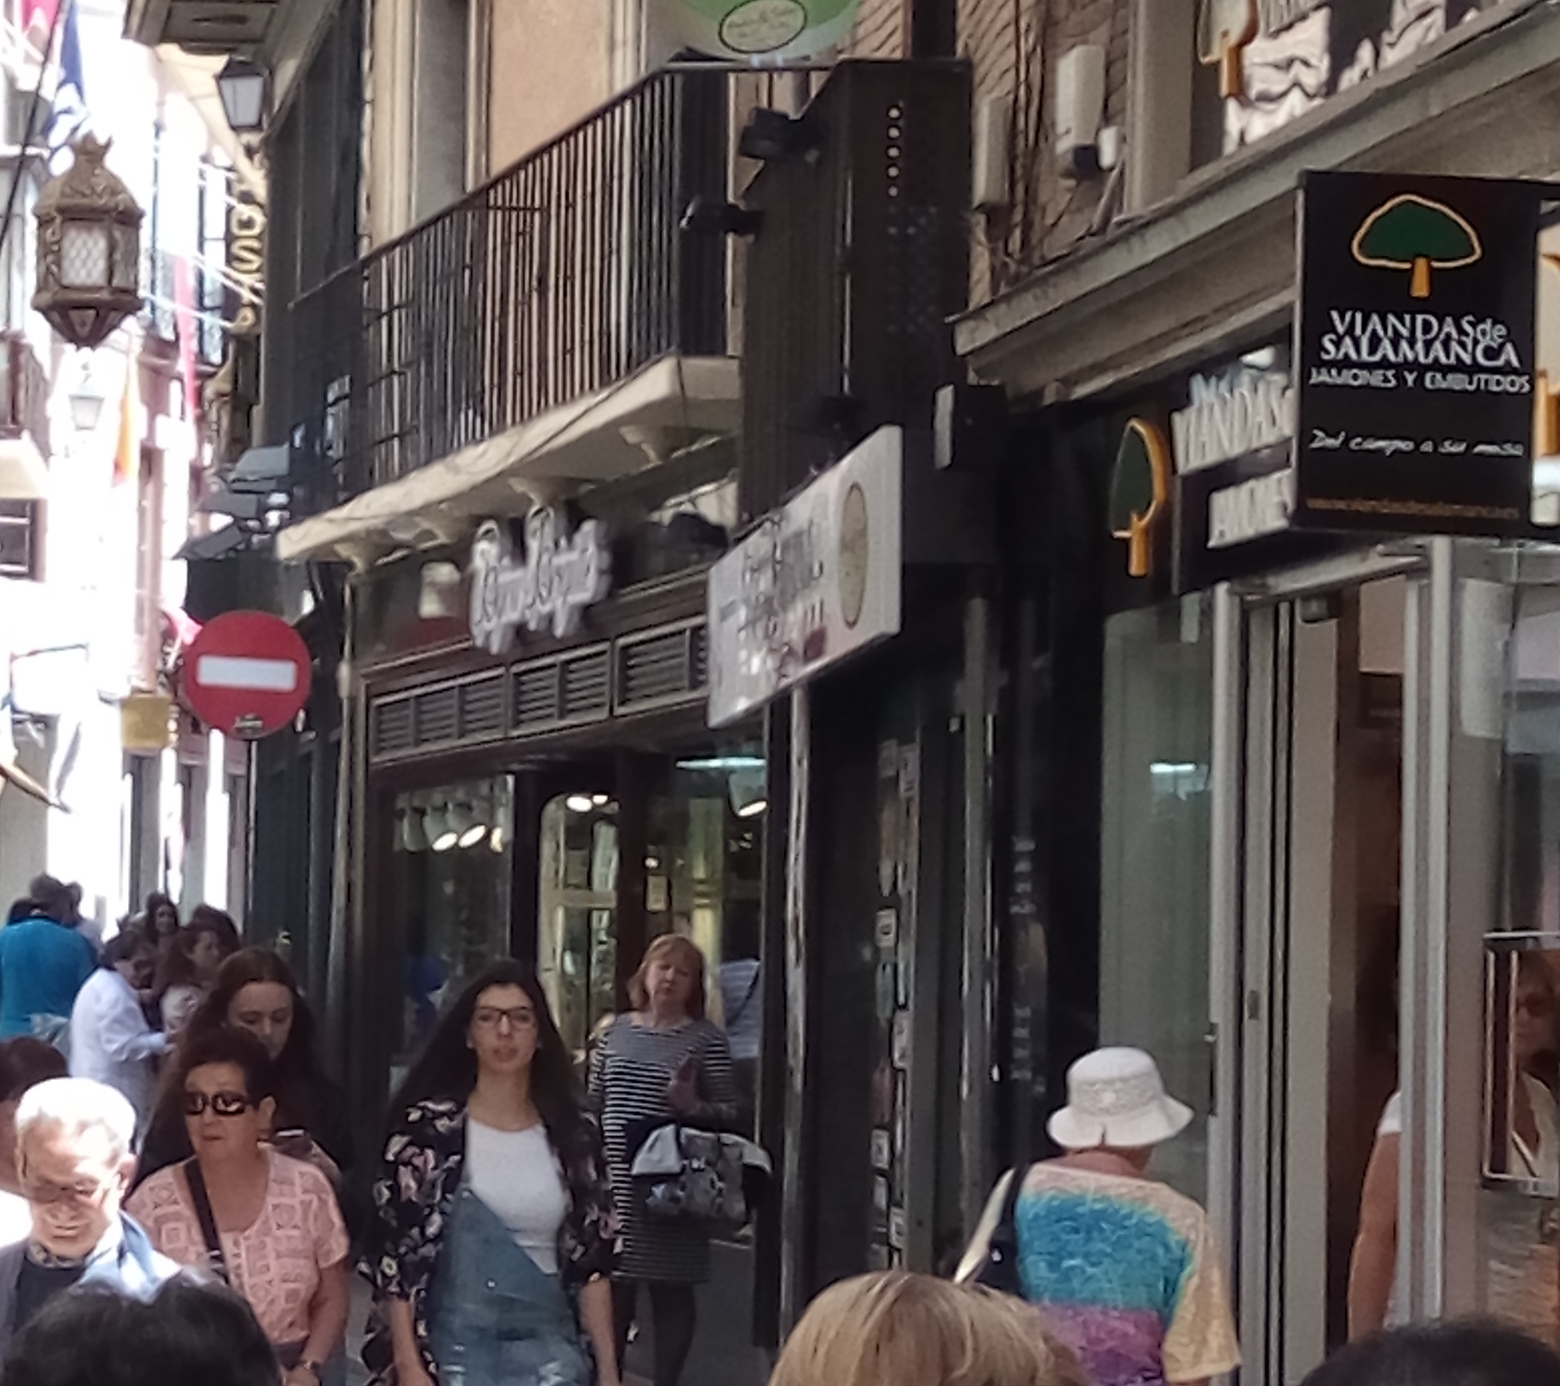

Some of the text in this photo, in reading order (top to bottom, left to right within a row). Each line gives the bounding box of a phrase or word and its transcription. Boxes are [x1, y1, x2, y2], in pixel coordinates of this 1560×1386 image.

[1330, 309, 1508, 344] VIANDAS de
[1320, 332, 1522, 369] SALAMANCA
[1309, 367, 1532, 394] JAMONES Y EMBUTIDOS
[1309, 428, 1525, 458] Del campo a su mesa
